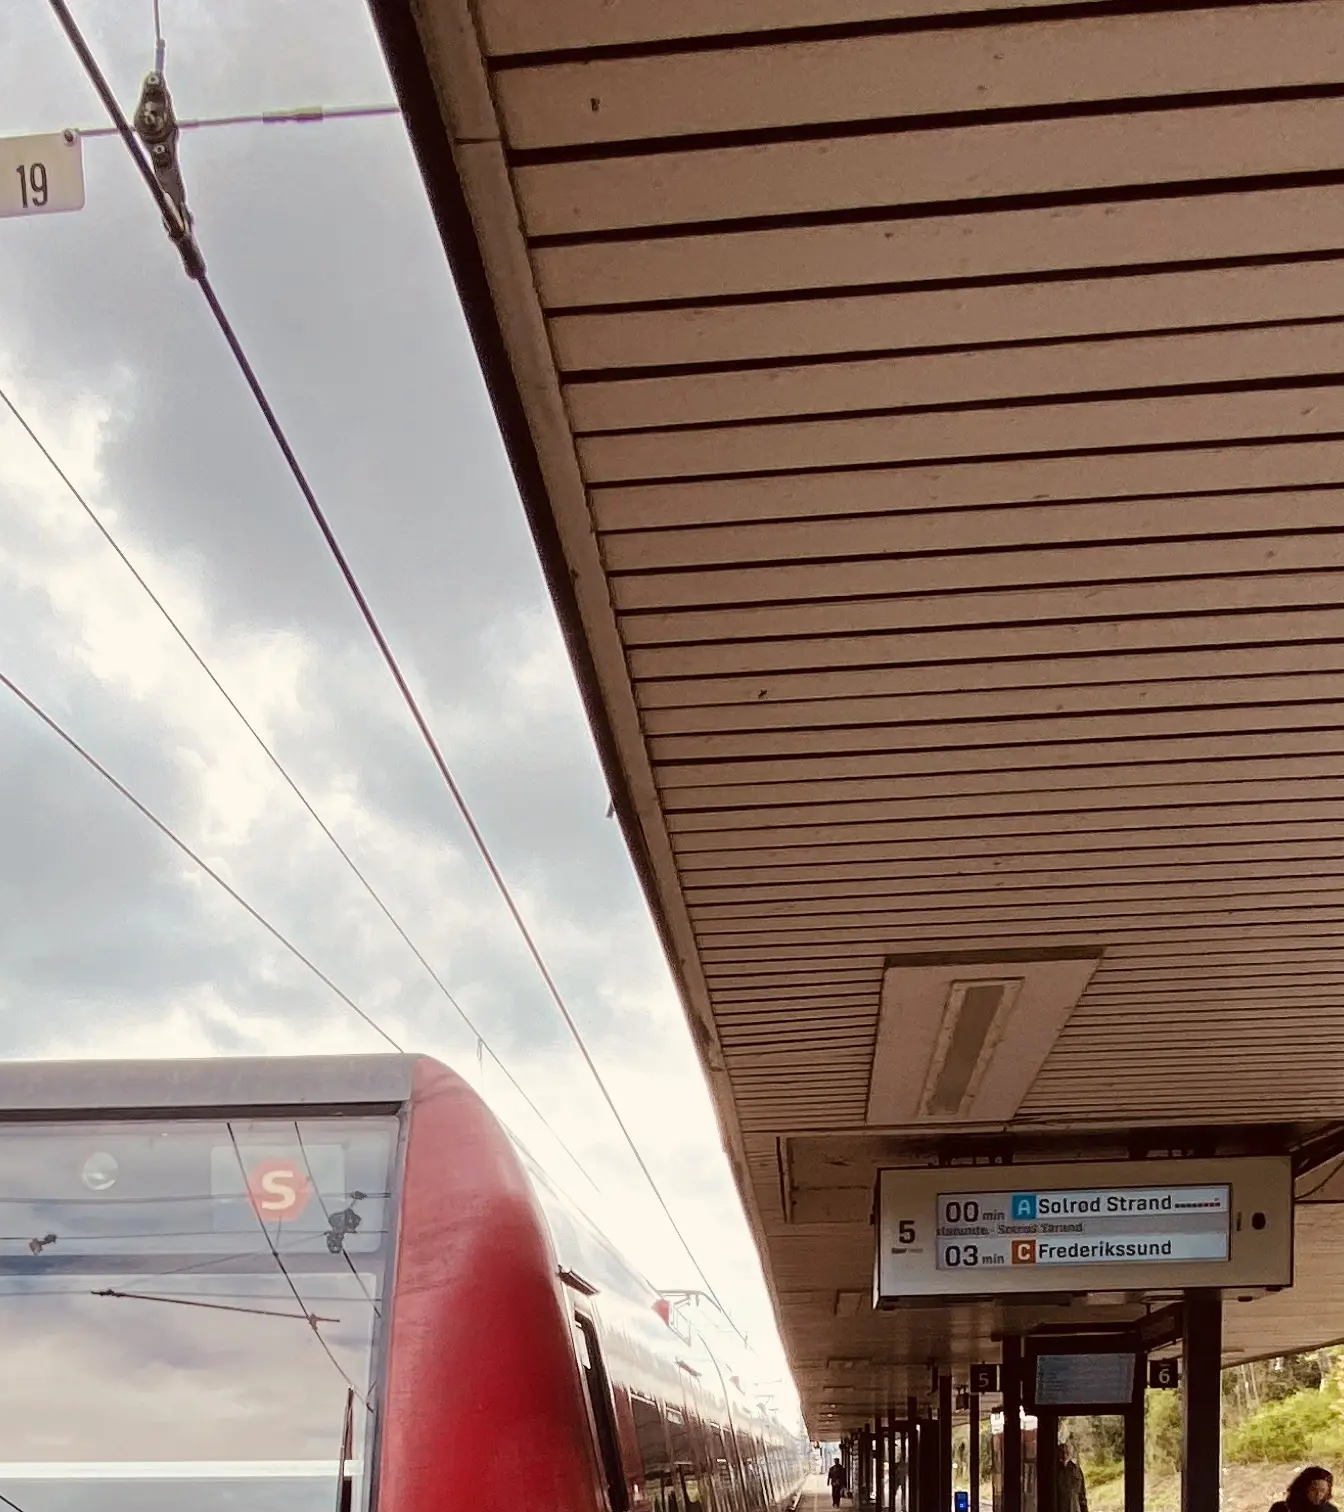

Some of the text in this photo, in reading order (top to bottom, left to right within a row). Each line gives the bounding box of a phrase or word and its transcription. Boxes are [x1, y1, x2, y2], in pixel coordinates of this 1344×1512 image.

[16, 162, 48, 208] 19
[261, 1170, 296, 1211] S
[945, 1201, 979, 1223] 00
[982, 1209, 1006, 1221] min
[1017, 1199, 1031, 1216] A
[1107, 1195, 1172, 1212] Strand
[898, 1220, 916, 1244] 5
[945, 1240, 1172, 1267] 03 min C Frederikssund
[978, 1372, 990, 1388] 5
[1158, 1368, 1171, 1385] 6
